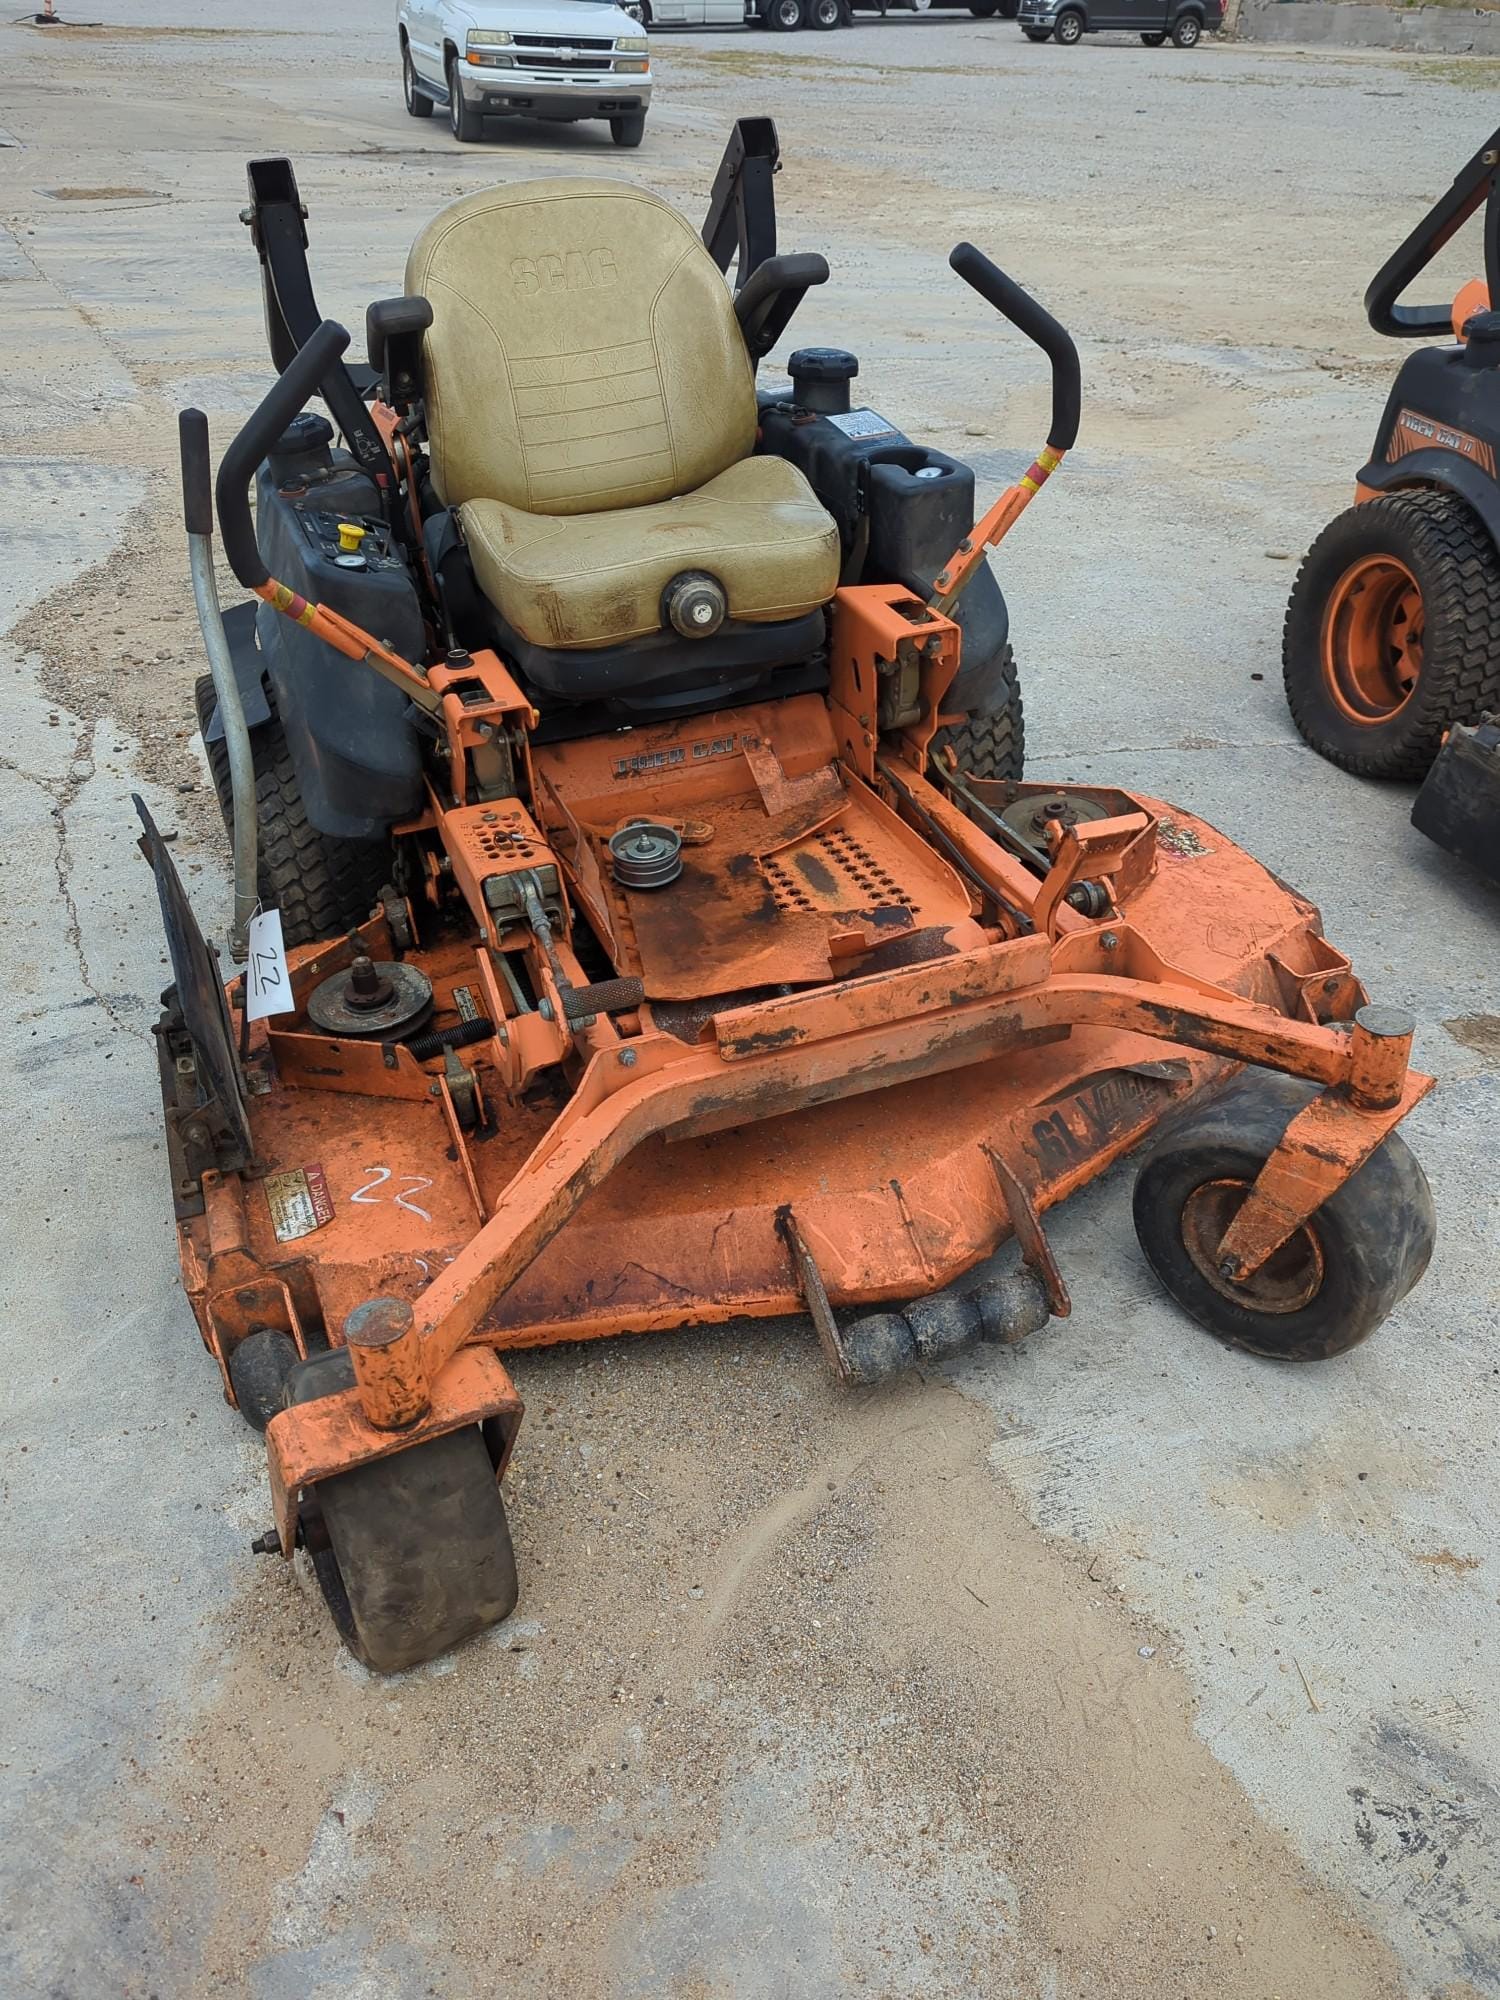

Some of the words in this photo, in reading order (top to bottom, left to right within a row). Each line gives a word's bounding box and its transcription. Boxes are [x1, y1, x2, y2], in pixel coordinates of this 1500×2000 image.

[510, 247, 618, 297] SCAG
[1400, 413, 1435, 439] TIGER
[1436, 427, 1462, 450] CAT
[692, 736, 735, 758] CAT
[256, 946, 281, 996] 22
[1031, 1110, 1082, 1158] 61
[310, 1183, 332, 1224] DANGER
[350, 1167, 433, 1223] 22
